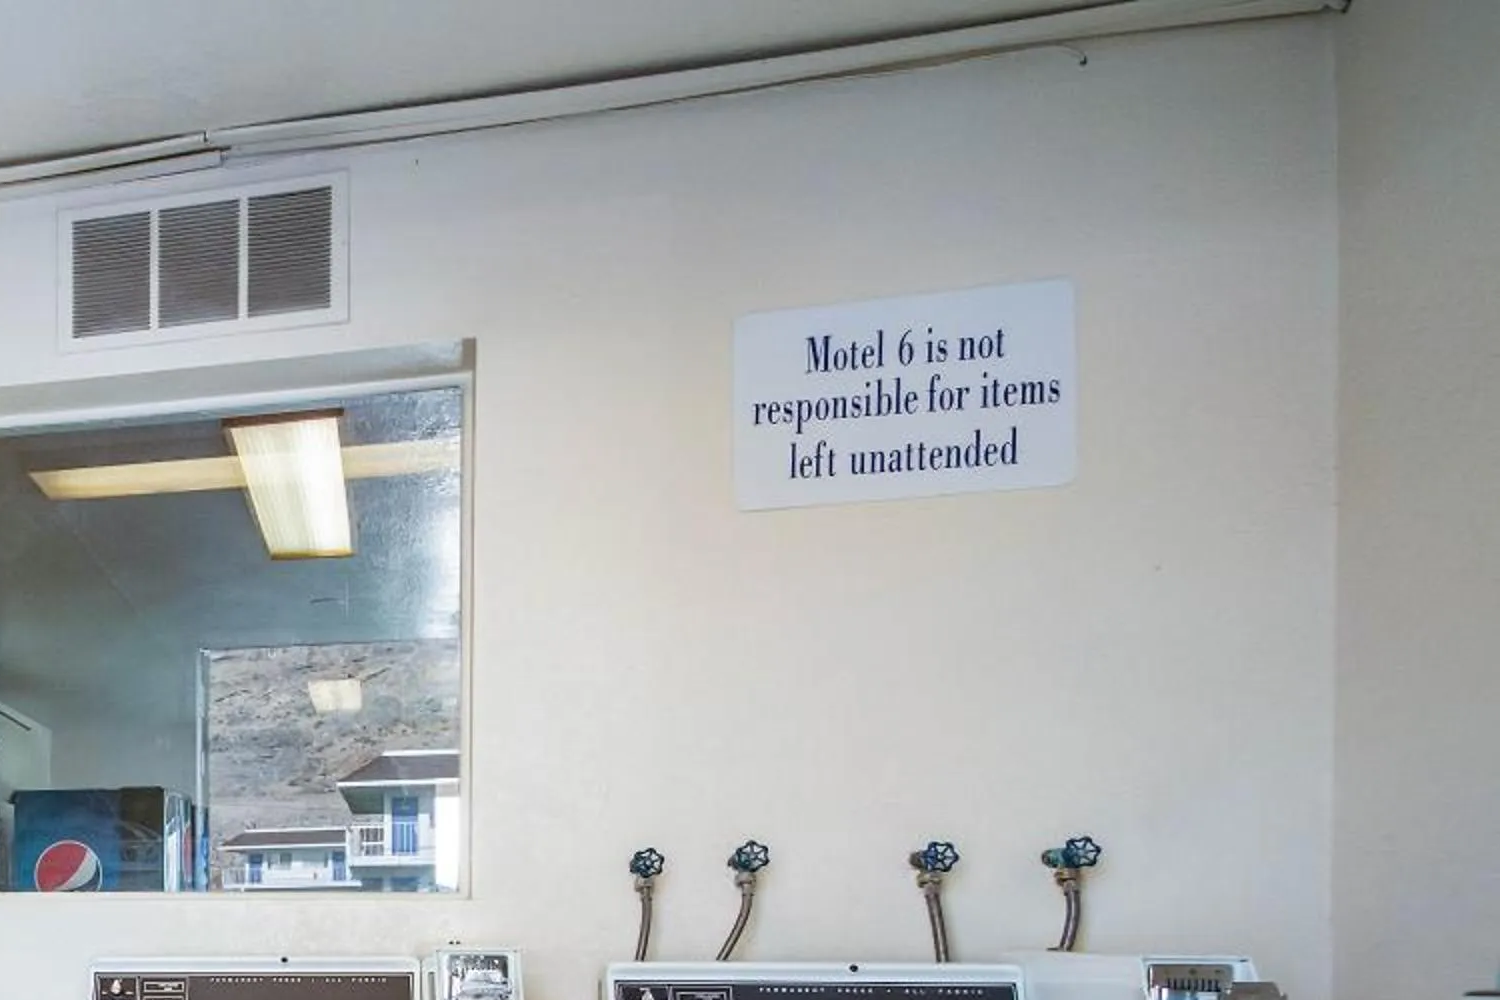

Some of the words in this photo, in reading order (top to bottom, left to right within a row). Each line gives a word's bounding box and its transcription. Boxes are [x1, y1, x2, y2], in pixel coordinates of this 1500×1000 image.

[804, 329, 884, 375] Motel
[898, 329, 914, 366] 6
[926, 327, 948, 363] is
[958, 328, 1006, 361] not
[752, 376, 919, 434] responsible
[927, 374, 971, 413] for
[980, 372, 1062, 409] items
[789, 440, 837, 479] left
[850, 426, 1019, 476] unattended
